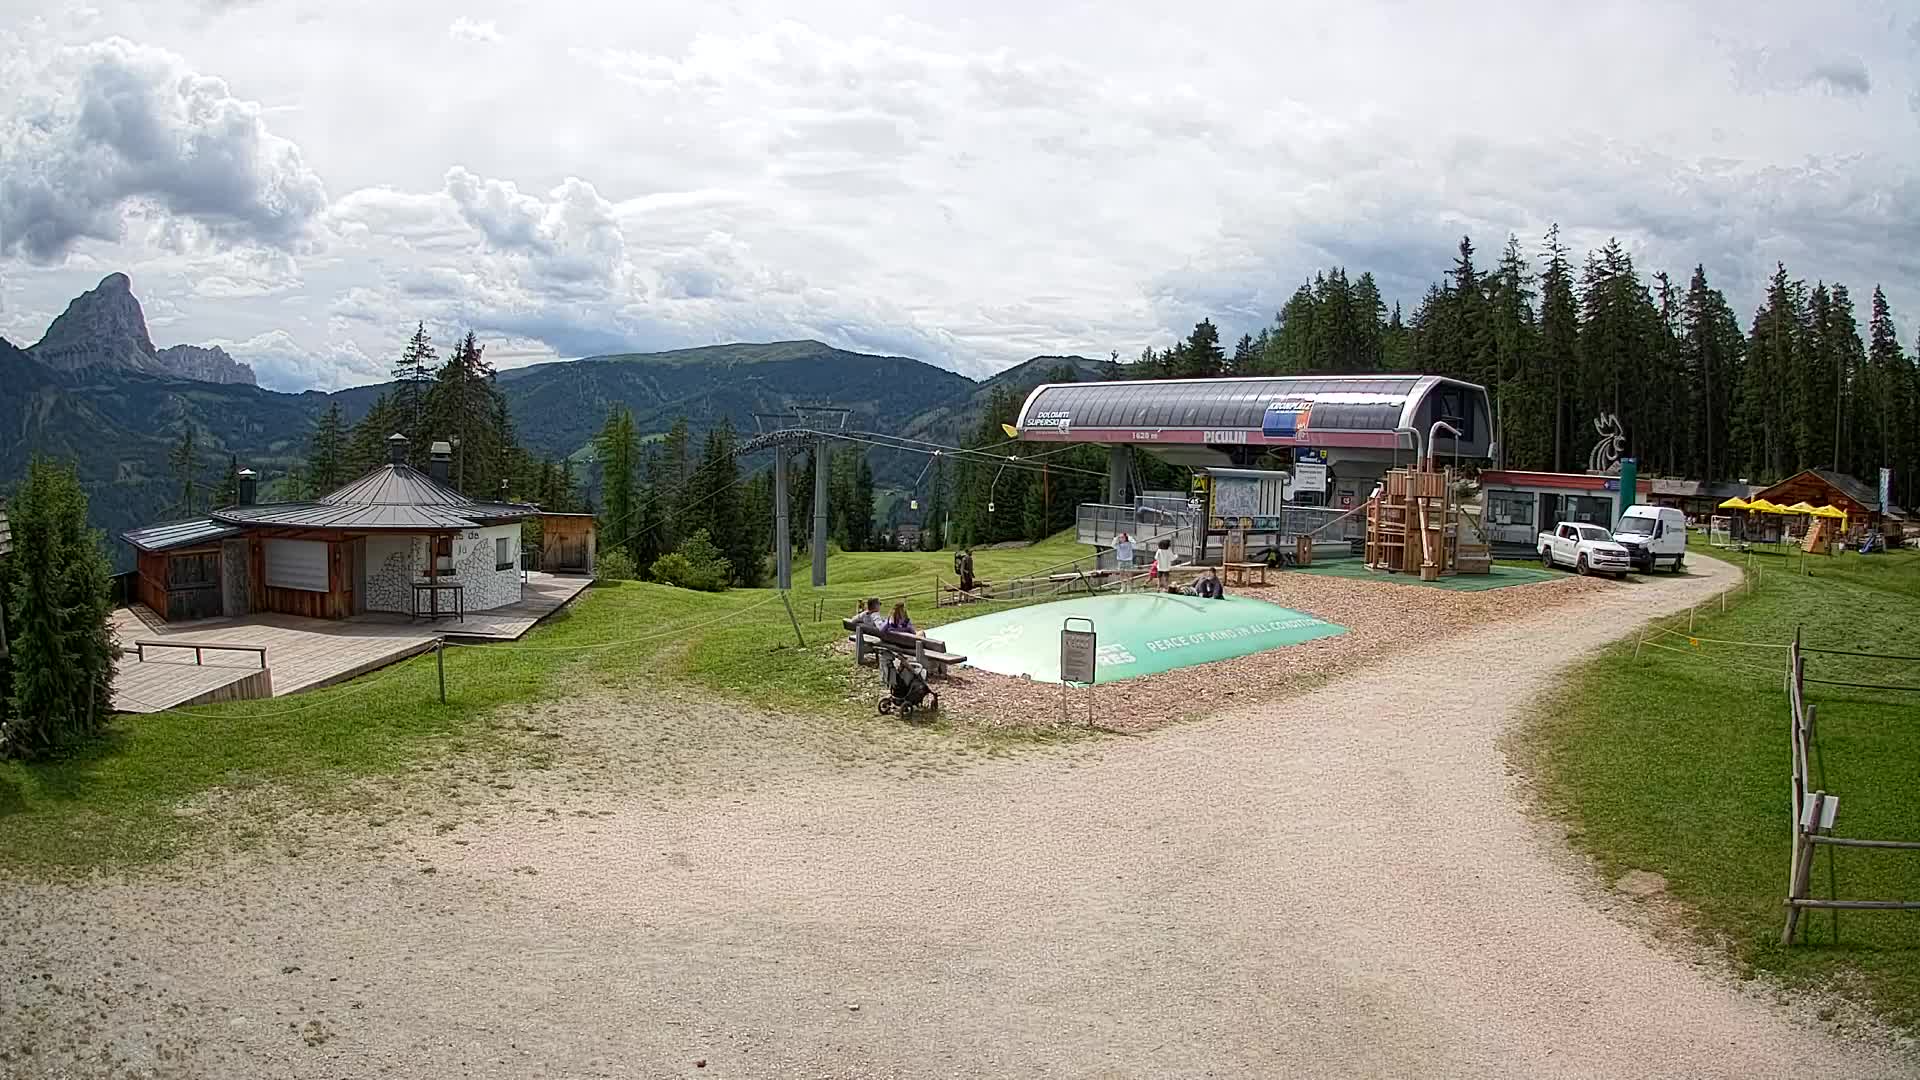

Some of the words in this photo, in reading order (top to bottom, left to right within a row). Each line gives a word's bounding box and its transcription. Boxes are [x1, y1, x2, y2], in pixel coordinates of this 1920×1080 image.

[1203, 431, 1246, 444] PICULIN
[1146, 636, 1190, 653] PEACE
[1190, 633, 1206, 644] OF
[1206, 628, 1237, 641] MIND
[1250, 623, 1271, 635] ALL
